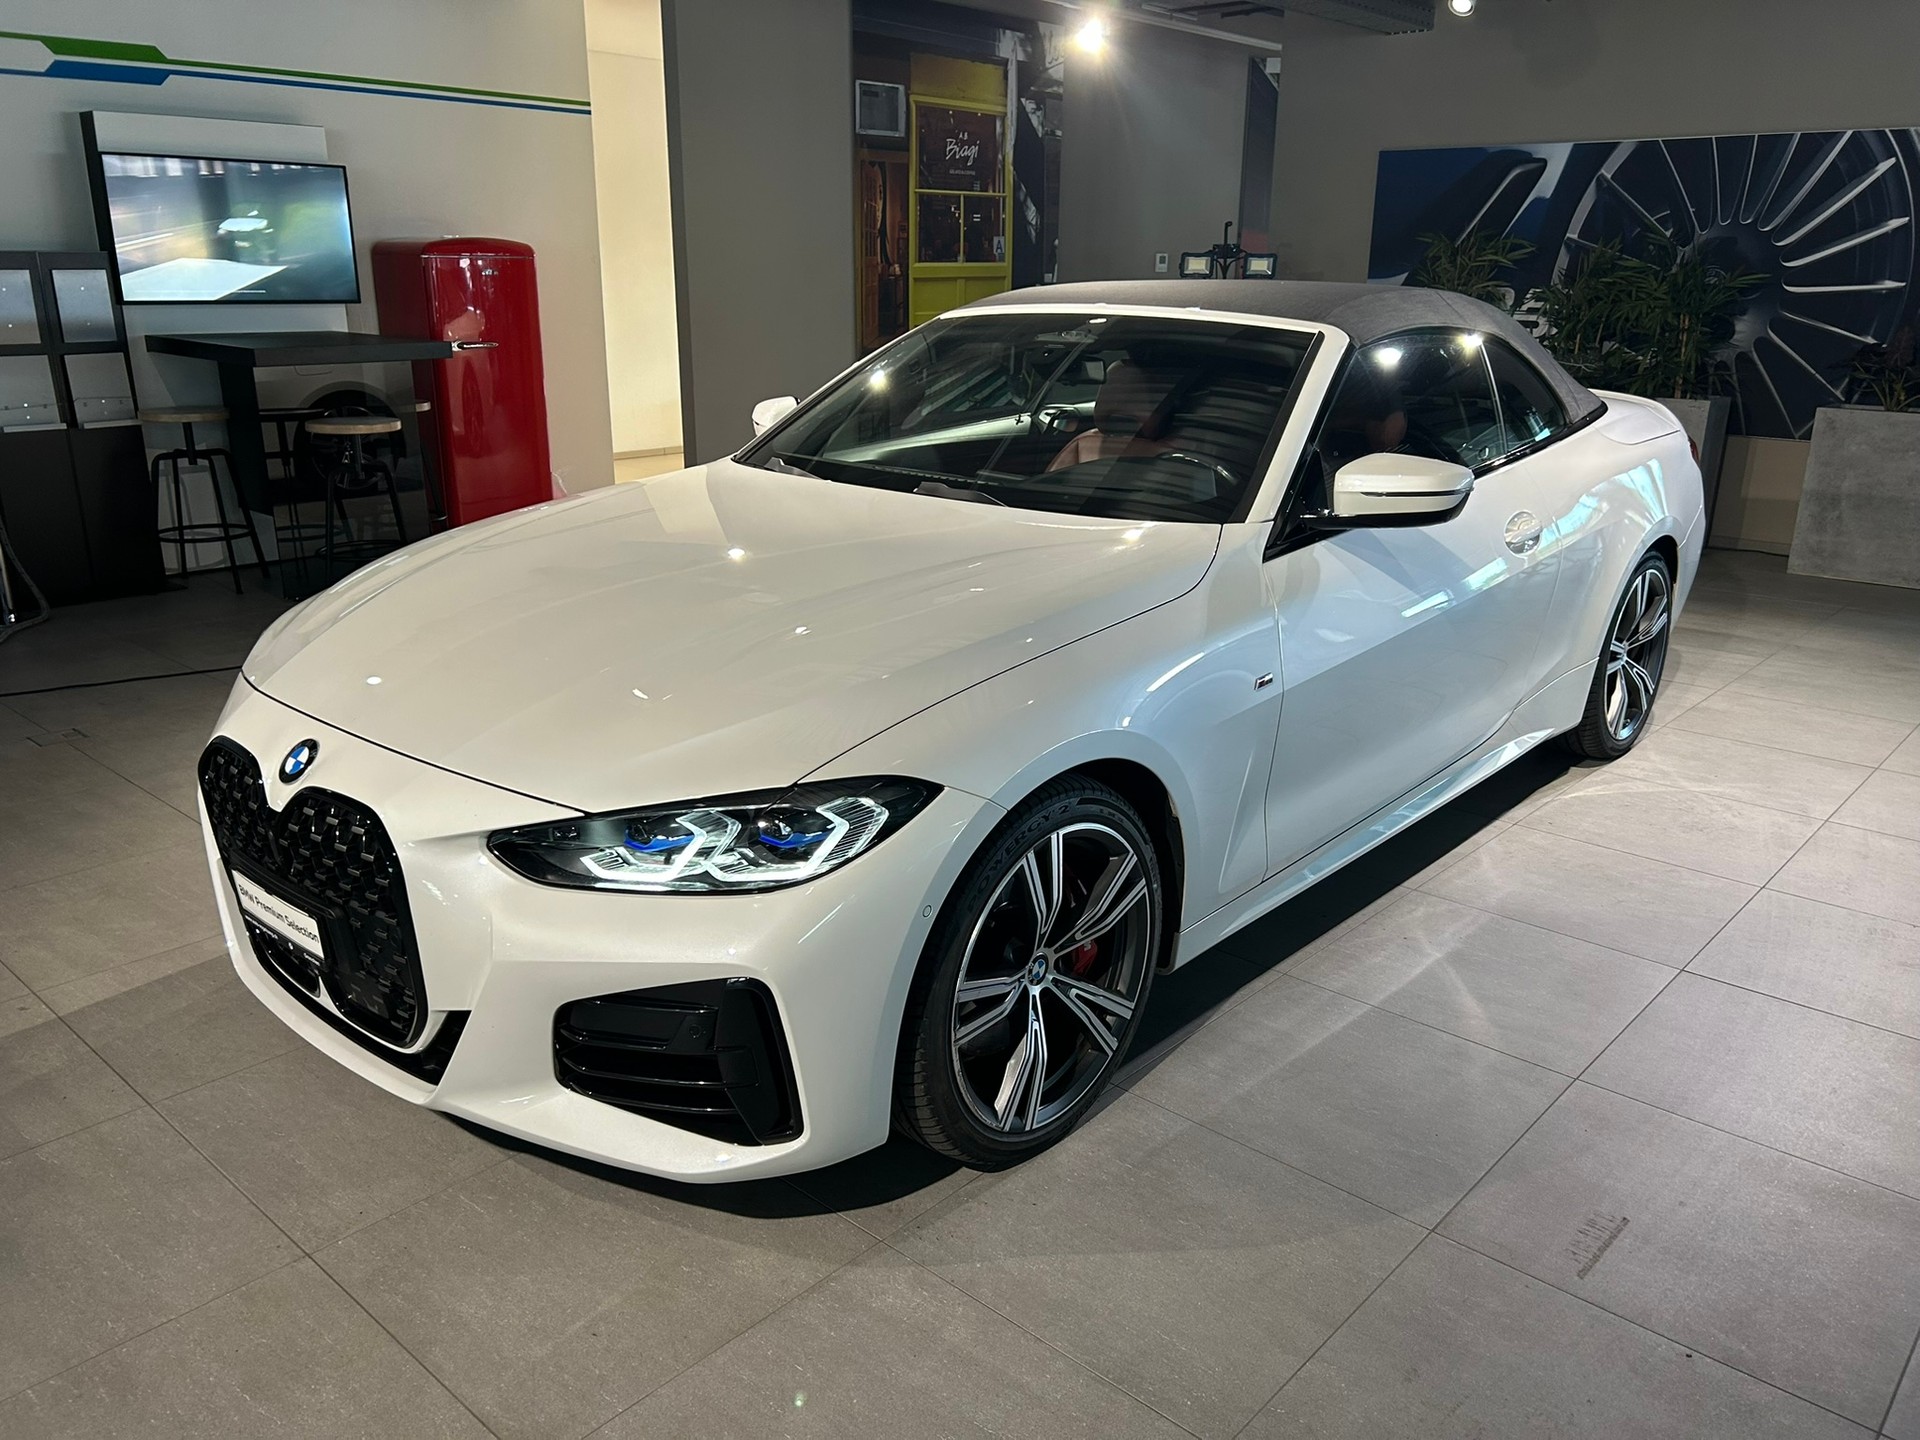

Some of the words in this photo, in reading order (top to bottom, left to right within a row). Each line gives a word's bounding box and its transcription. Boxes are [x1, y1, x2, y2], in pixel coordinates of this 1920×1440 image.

[945, 138, 980, 166] Biagi
[254, 896, 286, 924] Premium
[284, 914, 320, 944] Selection
